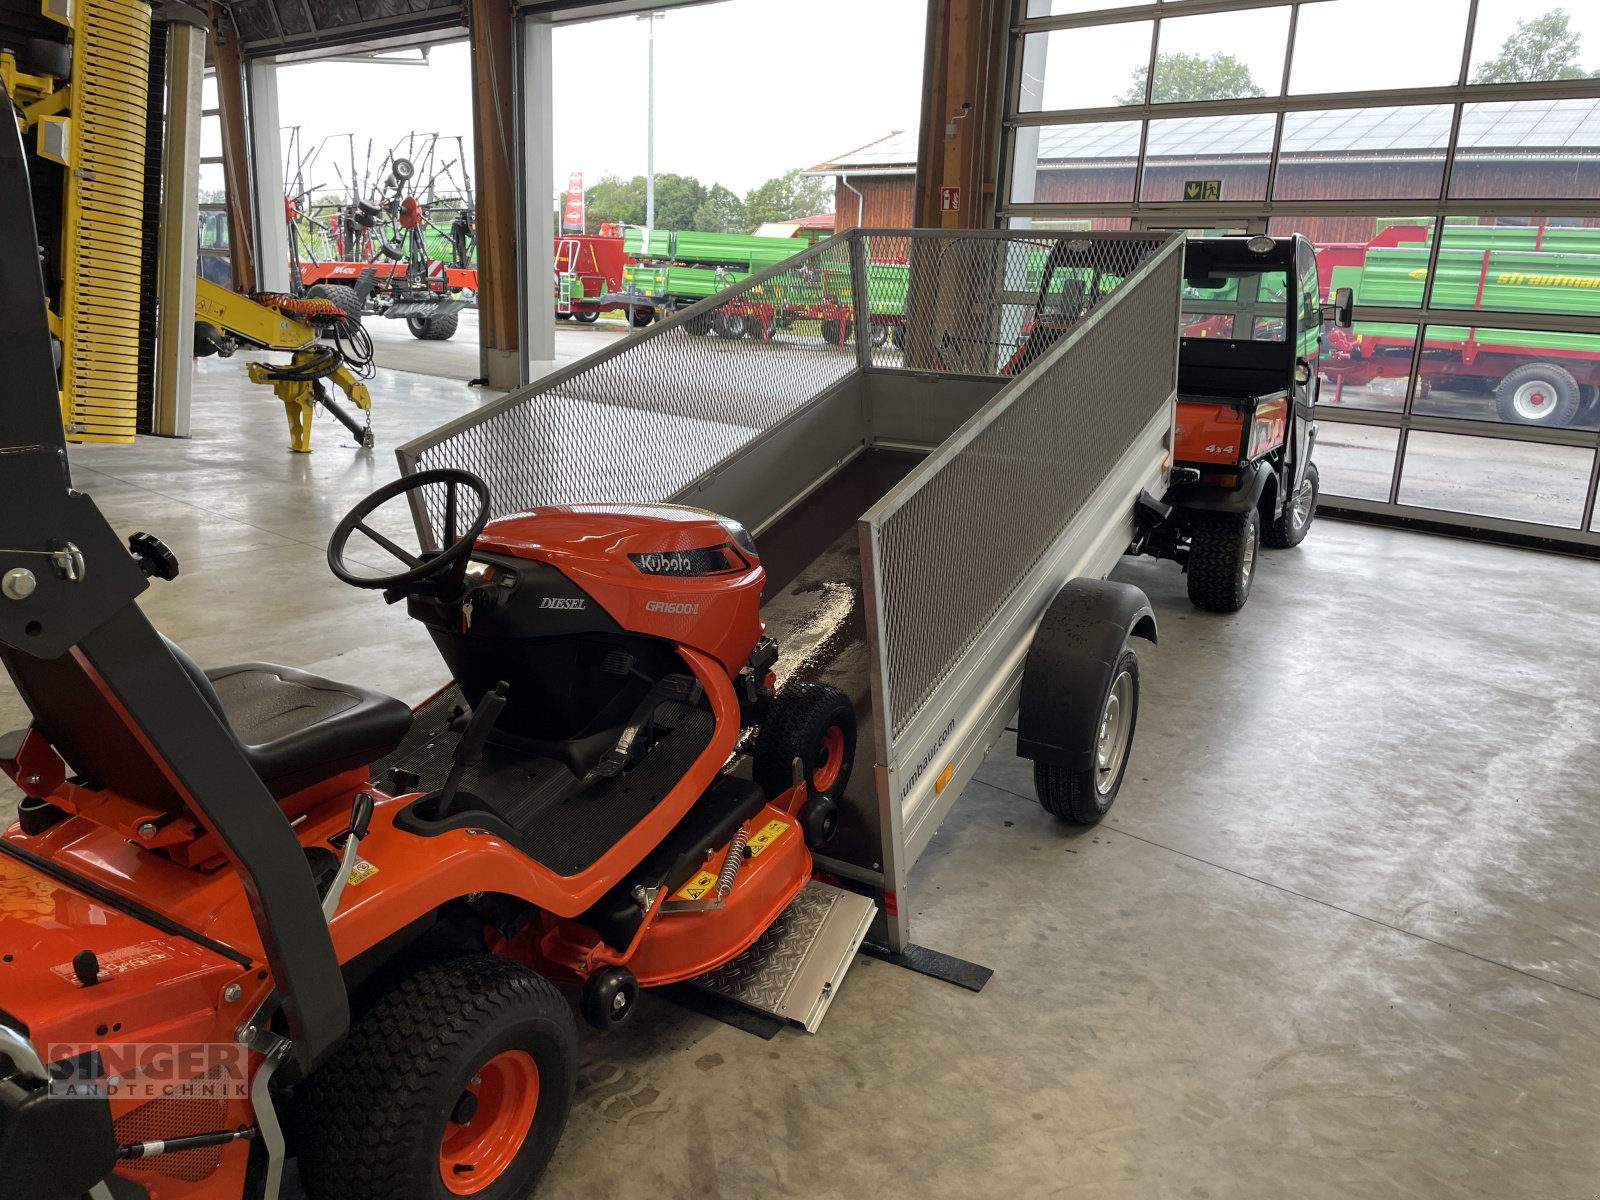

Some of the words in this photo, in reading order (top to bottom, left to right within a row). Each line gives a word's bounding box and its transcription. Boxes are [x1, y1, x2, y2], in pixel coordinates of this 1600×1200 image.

[1205, 444, 1234, 454] 4x4
[640, 553, 691, 572] Kubota
[539, 597, 586, 610] DIESEL
